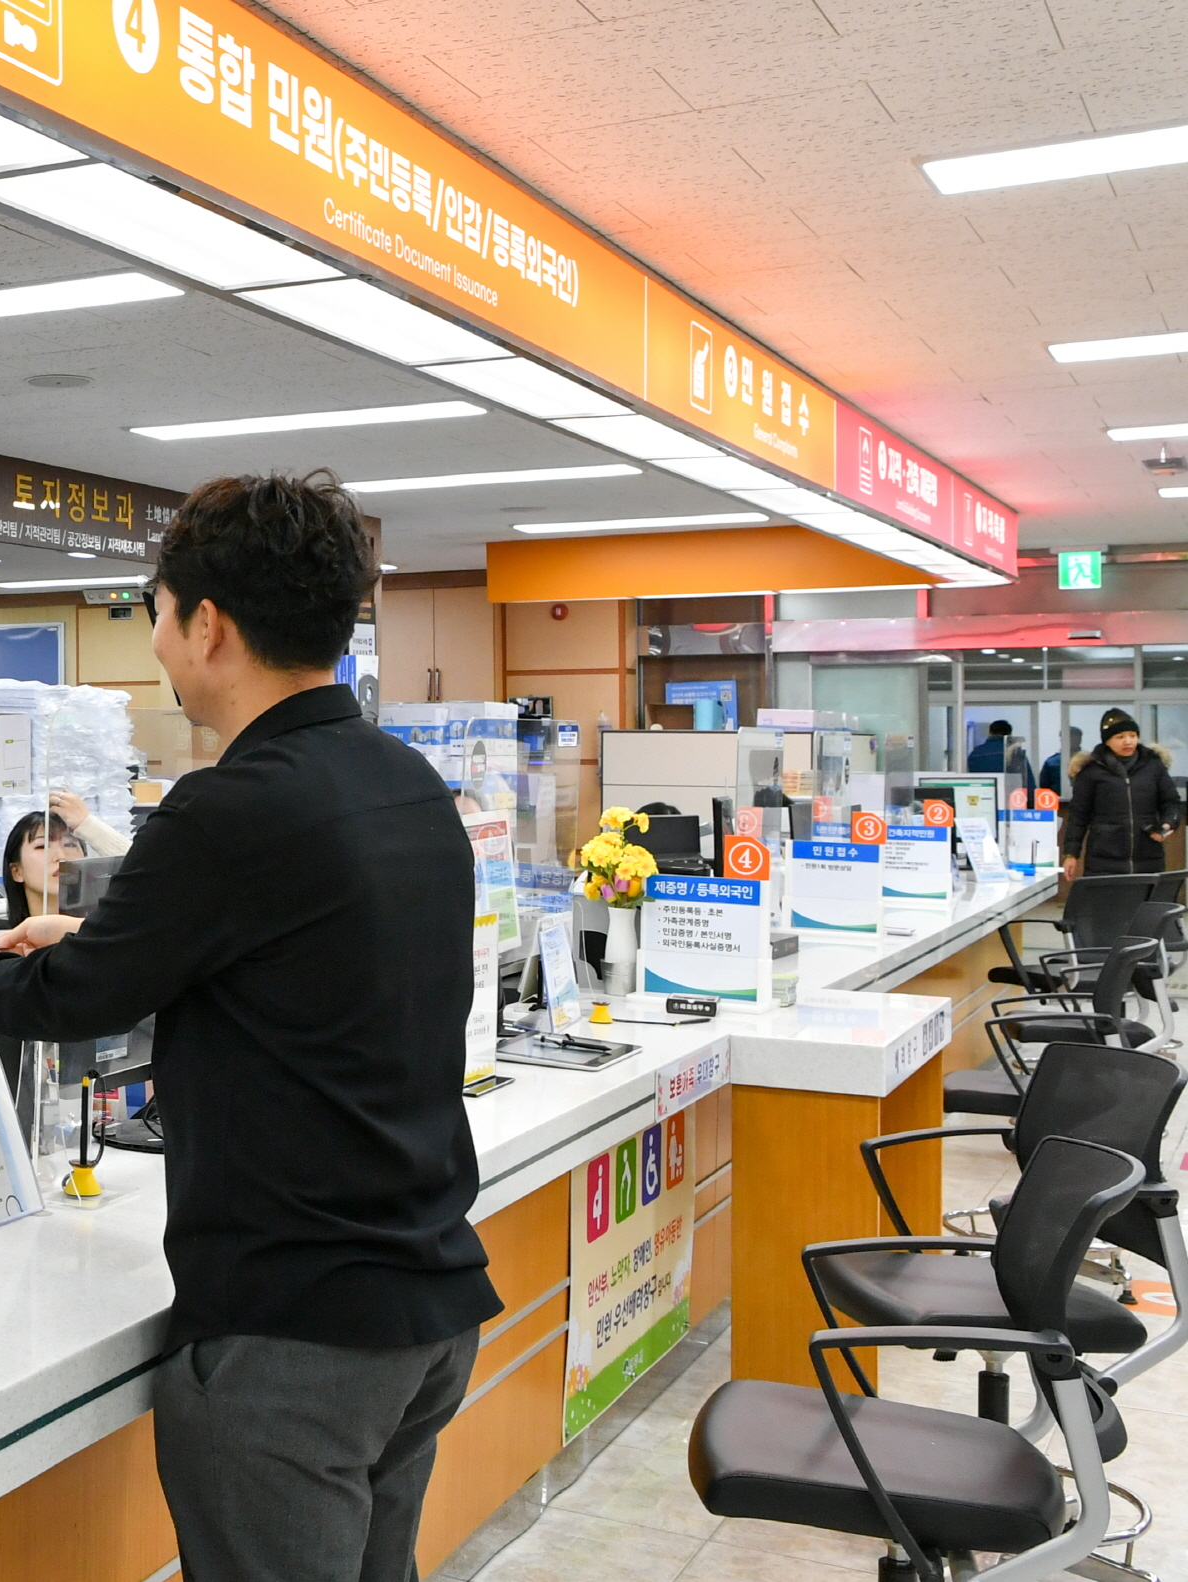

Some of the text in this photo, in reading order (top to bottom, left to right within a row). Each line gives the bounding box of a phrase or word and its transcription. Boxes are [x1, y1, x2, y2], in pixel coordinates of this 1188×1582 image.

[177, 6, 255, 129] 통합
[268, 61, 579, 307] 민원(주민등록/인감/등록외국인)
[323, 197, 499, 307] Certificate Document Issuance
[12, 474, 135, 531] 토지정보과
[25, 524, 61, 545] 지적관리팀
[67, 530, 101, 551] 공간정보팀
[107, 536, 146, 557] 지적재조사팀
[654, 880, 688, 896] 제증명
[696, 883, 754, 900] 등록외국인
[662, 917, 710, 928] 가족관계증명
[700, 930, 732, 941] 본인서명
[662, 938, 741, 953] 외국인등록사실증명서
[669, 1053, 720, 1100] 보훈가족 우대창구
[653, 1215, 683, 1258] 영유아동반
[596, 1309, 612, 1350] 민원
